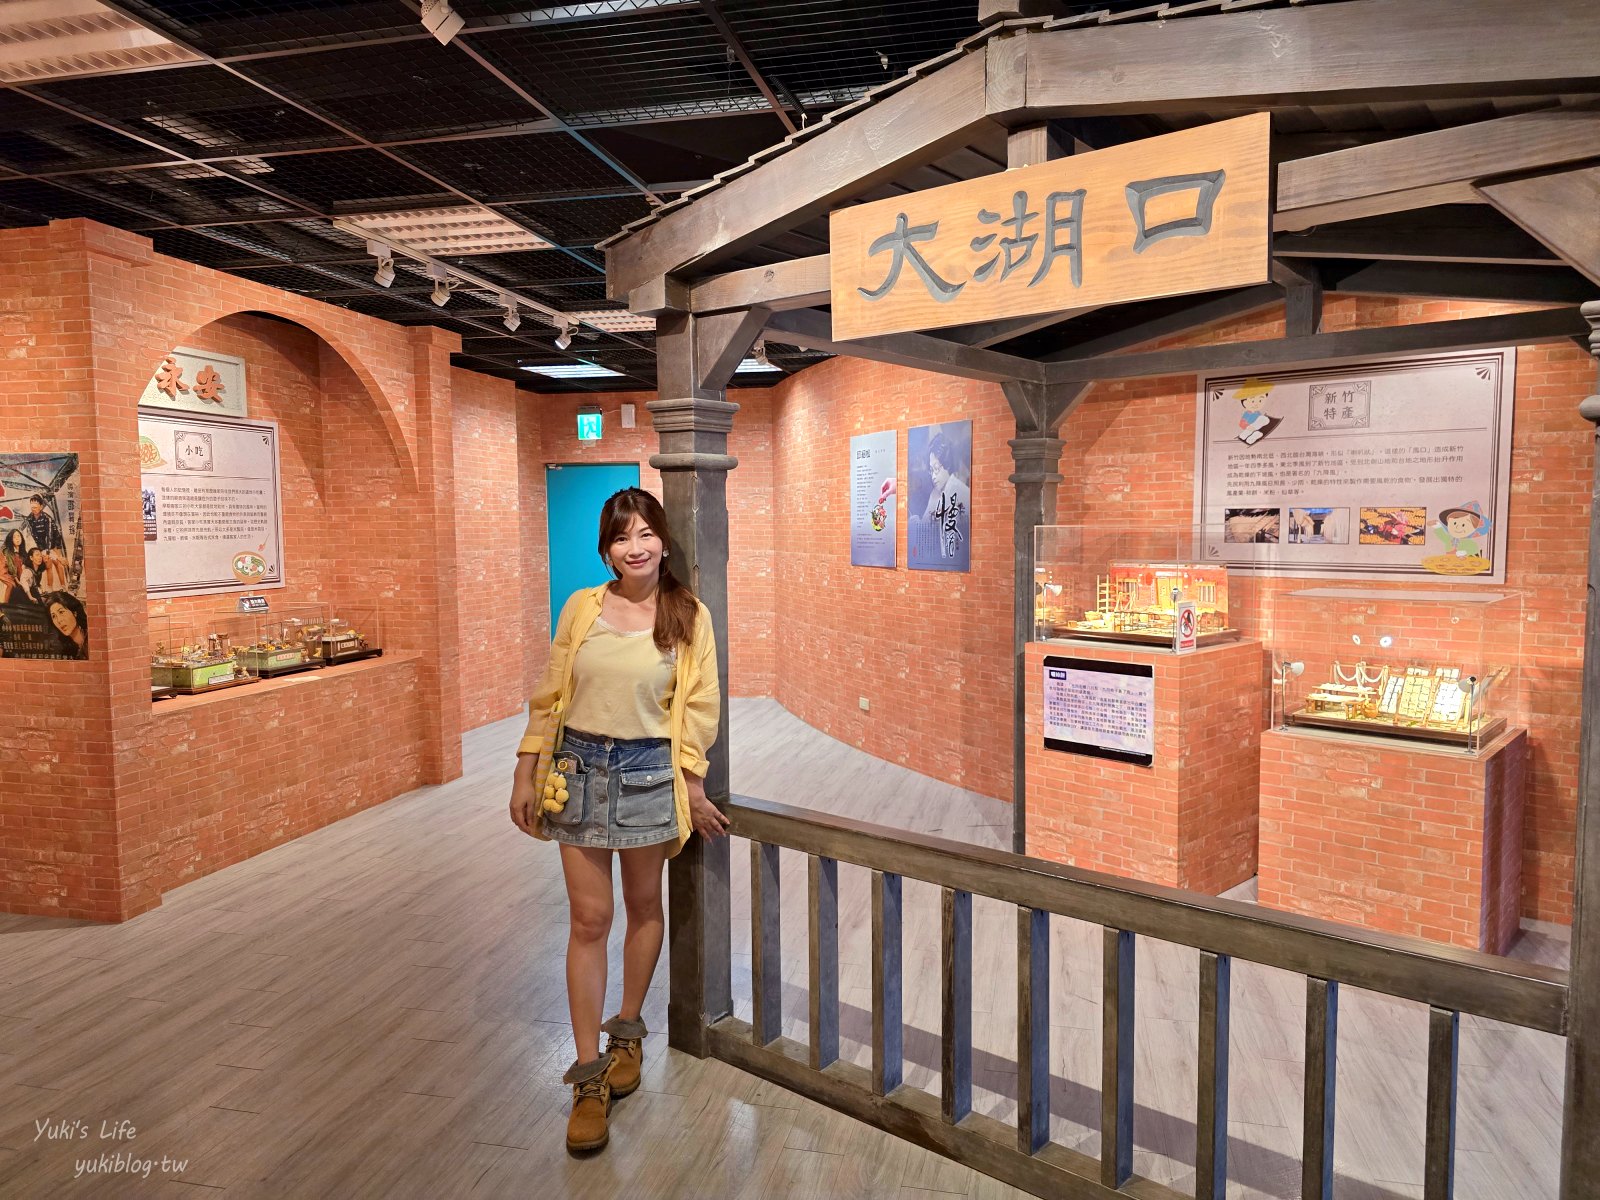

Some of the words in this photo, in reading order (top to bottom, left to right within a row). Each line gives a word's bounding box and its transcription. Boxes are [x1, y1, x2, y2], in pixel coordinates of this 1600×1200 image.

[857, 168, 1226, 303] 大湖口
[155, 357, 225, 404] 永安
[1325, 390, 1355, 405] 新竹
[1323, 406, 1354, 420] 特產
[185, 445, 204, 457] 小吃
